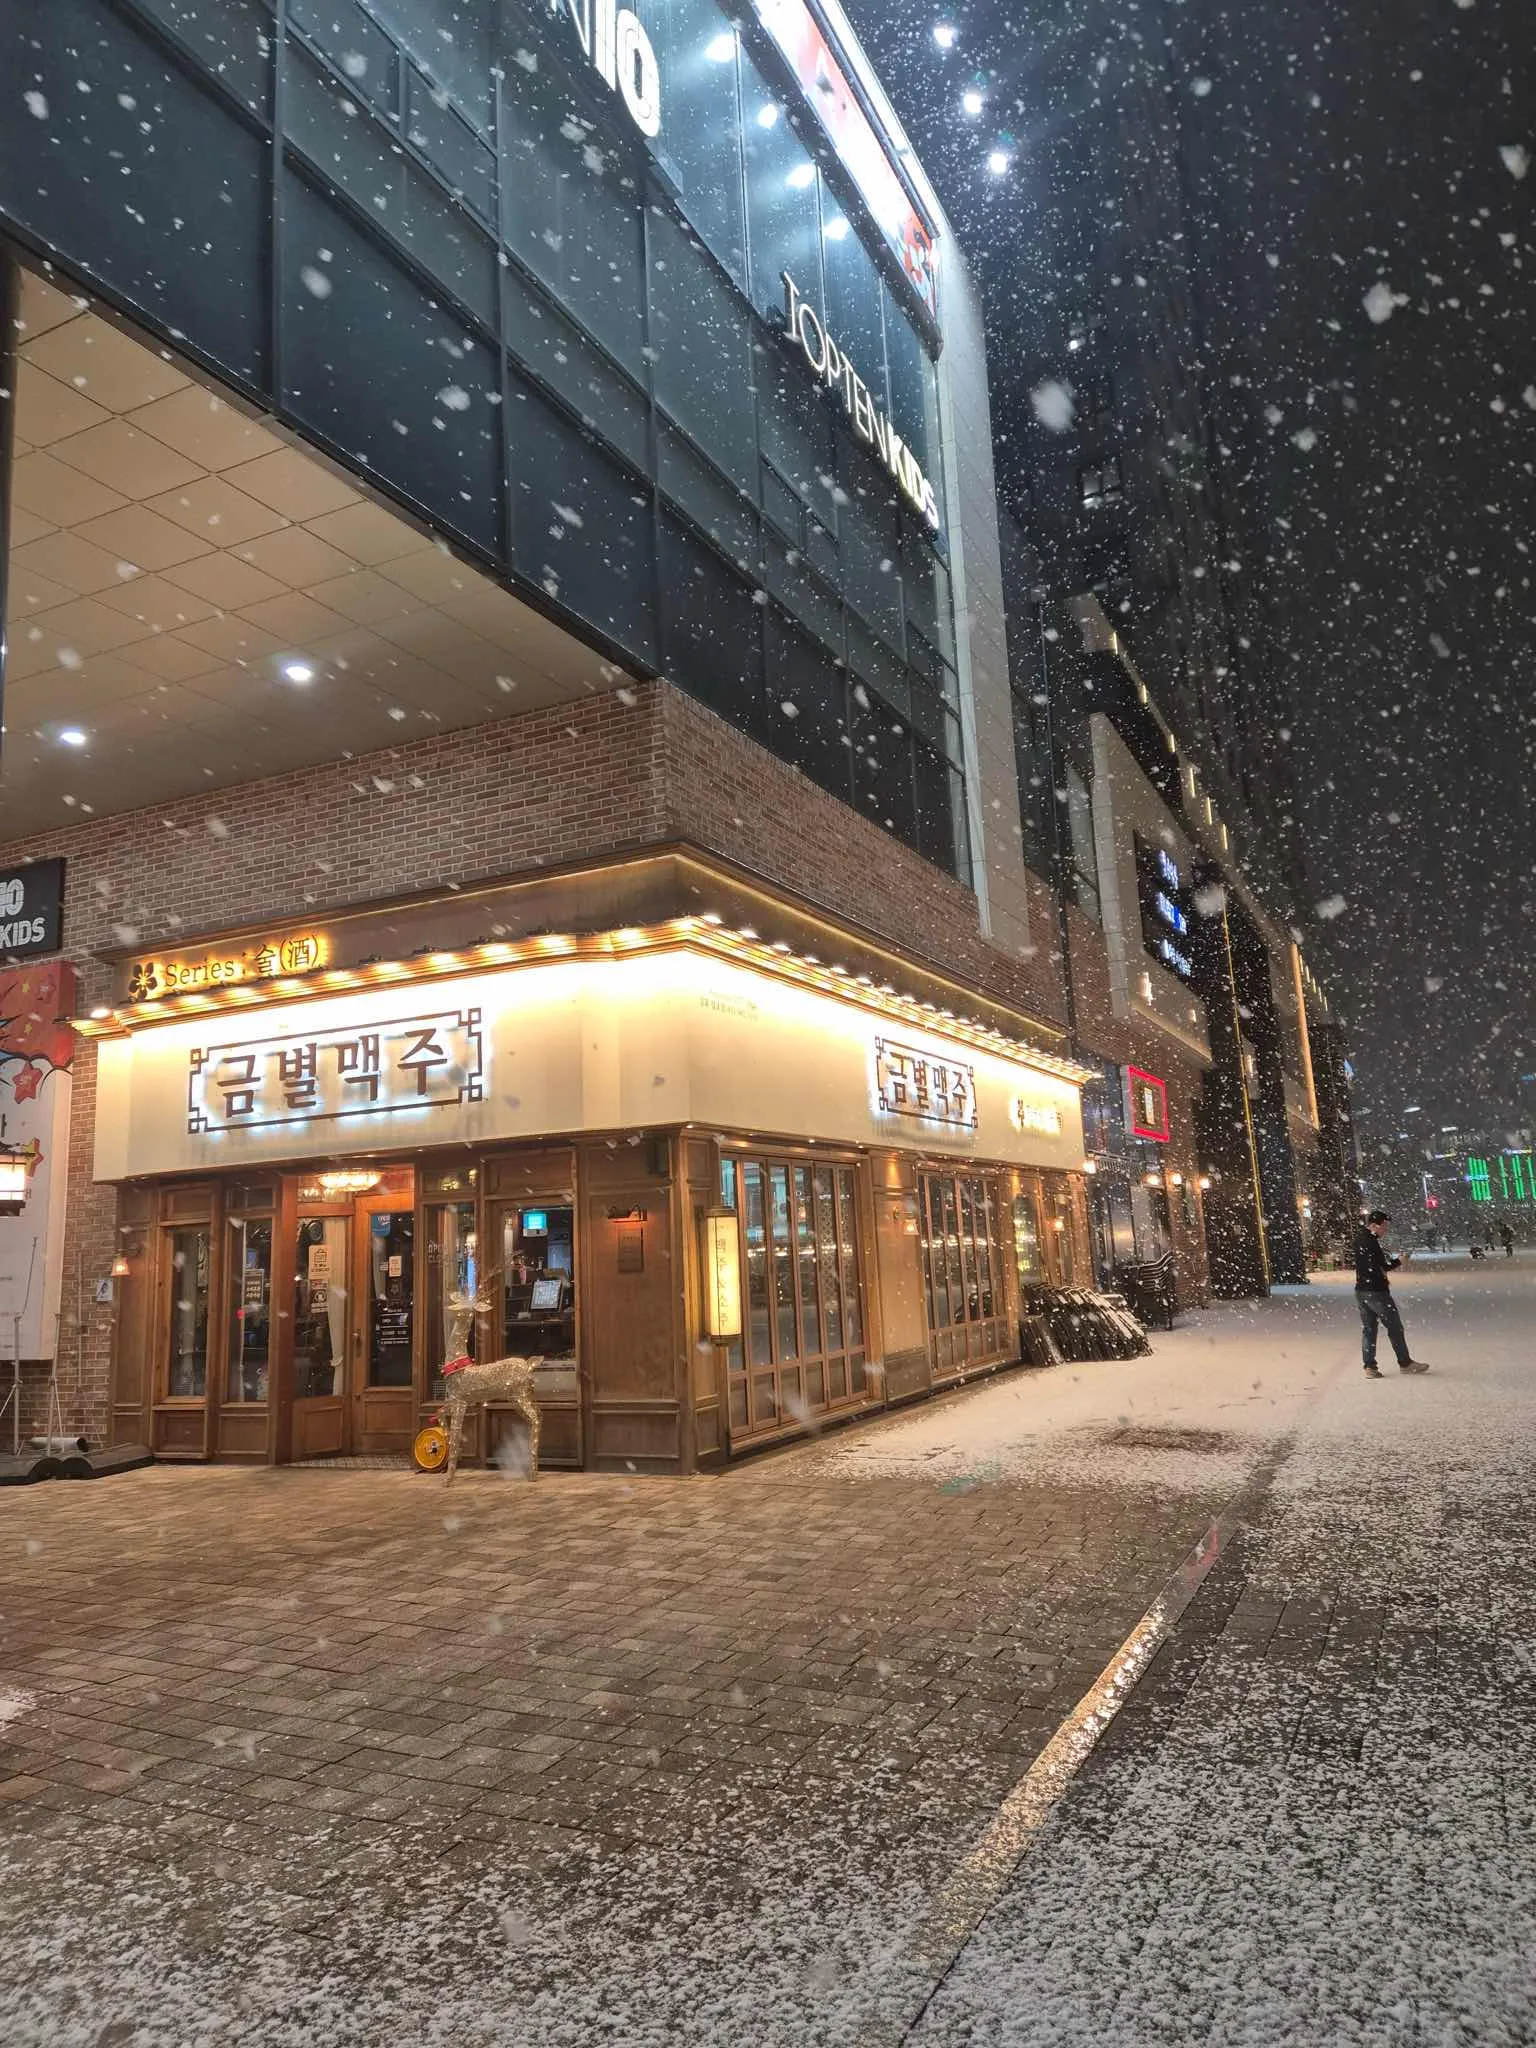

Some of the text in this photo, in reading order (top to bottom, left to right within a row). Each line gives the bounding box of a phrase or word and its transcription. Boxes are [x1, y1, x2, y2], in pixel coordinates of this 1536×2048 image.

[0, 916, 46, 949] KIDS
[164, 957, 235, 987] Series
[216, 1027, 449, 1118] 금별맥주
[888, 1051, 967, 1118] 금별맥주
